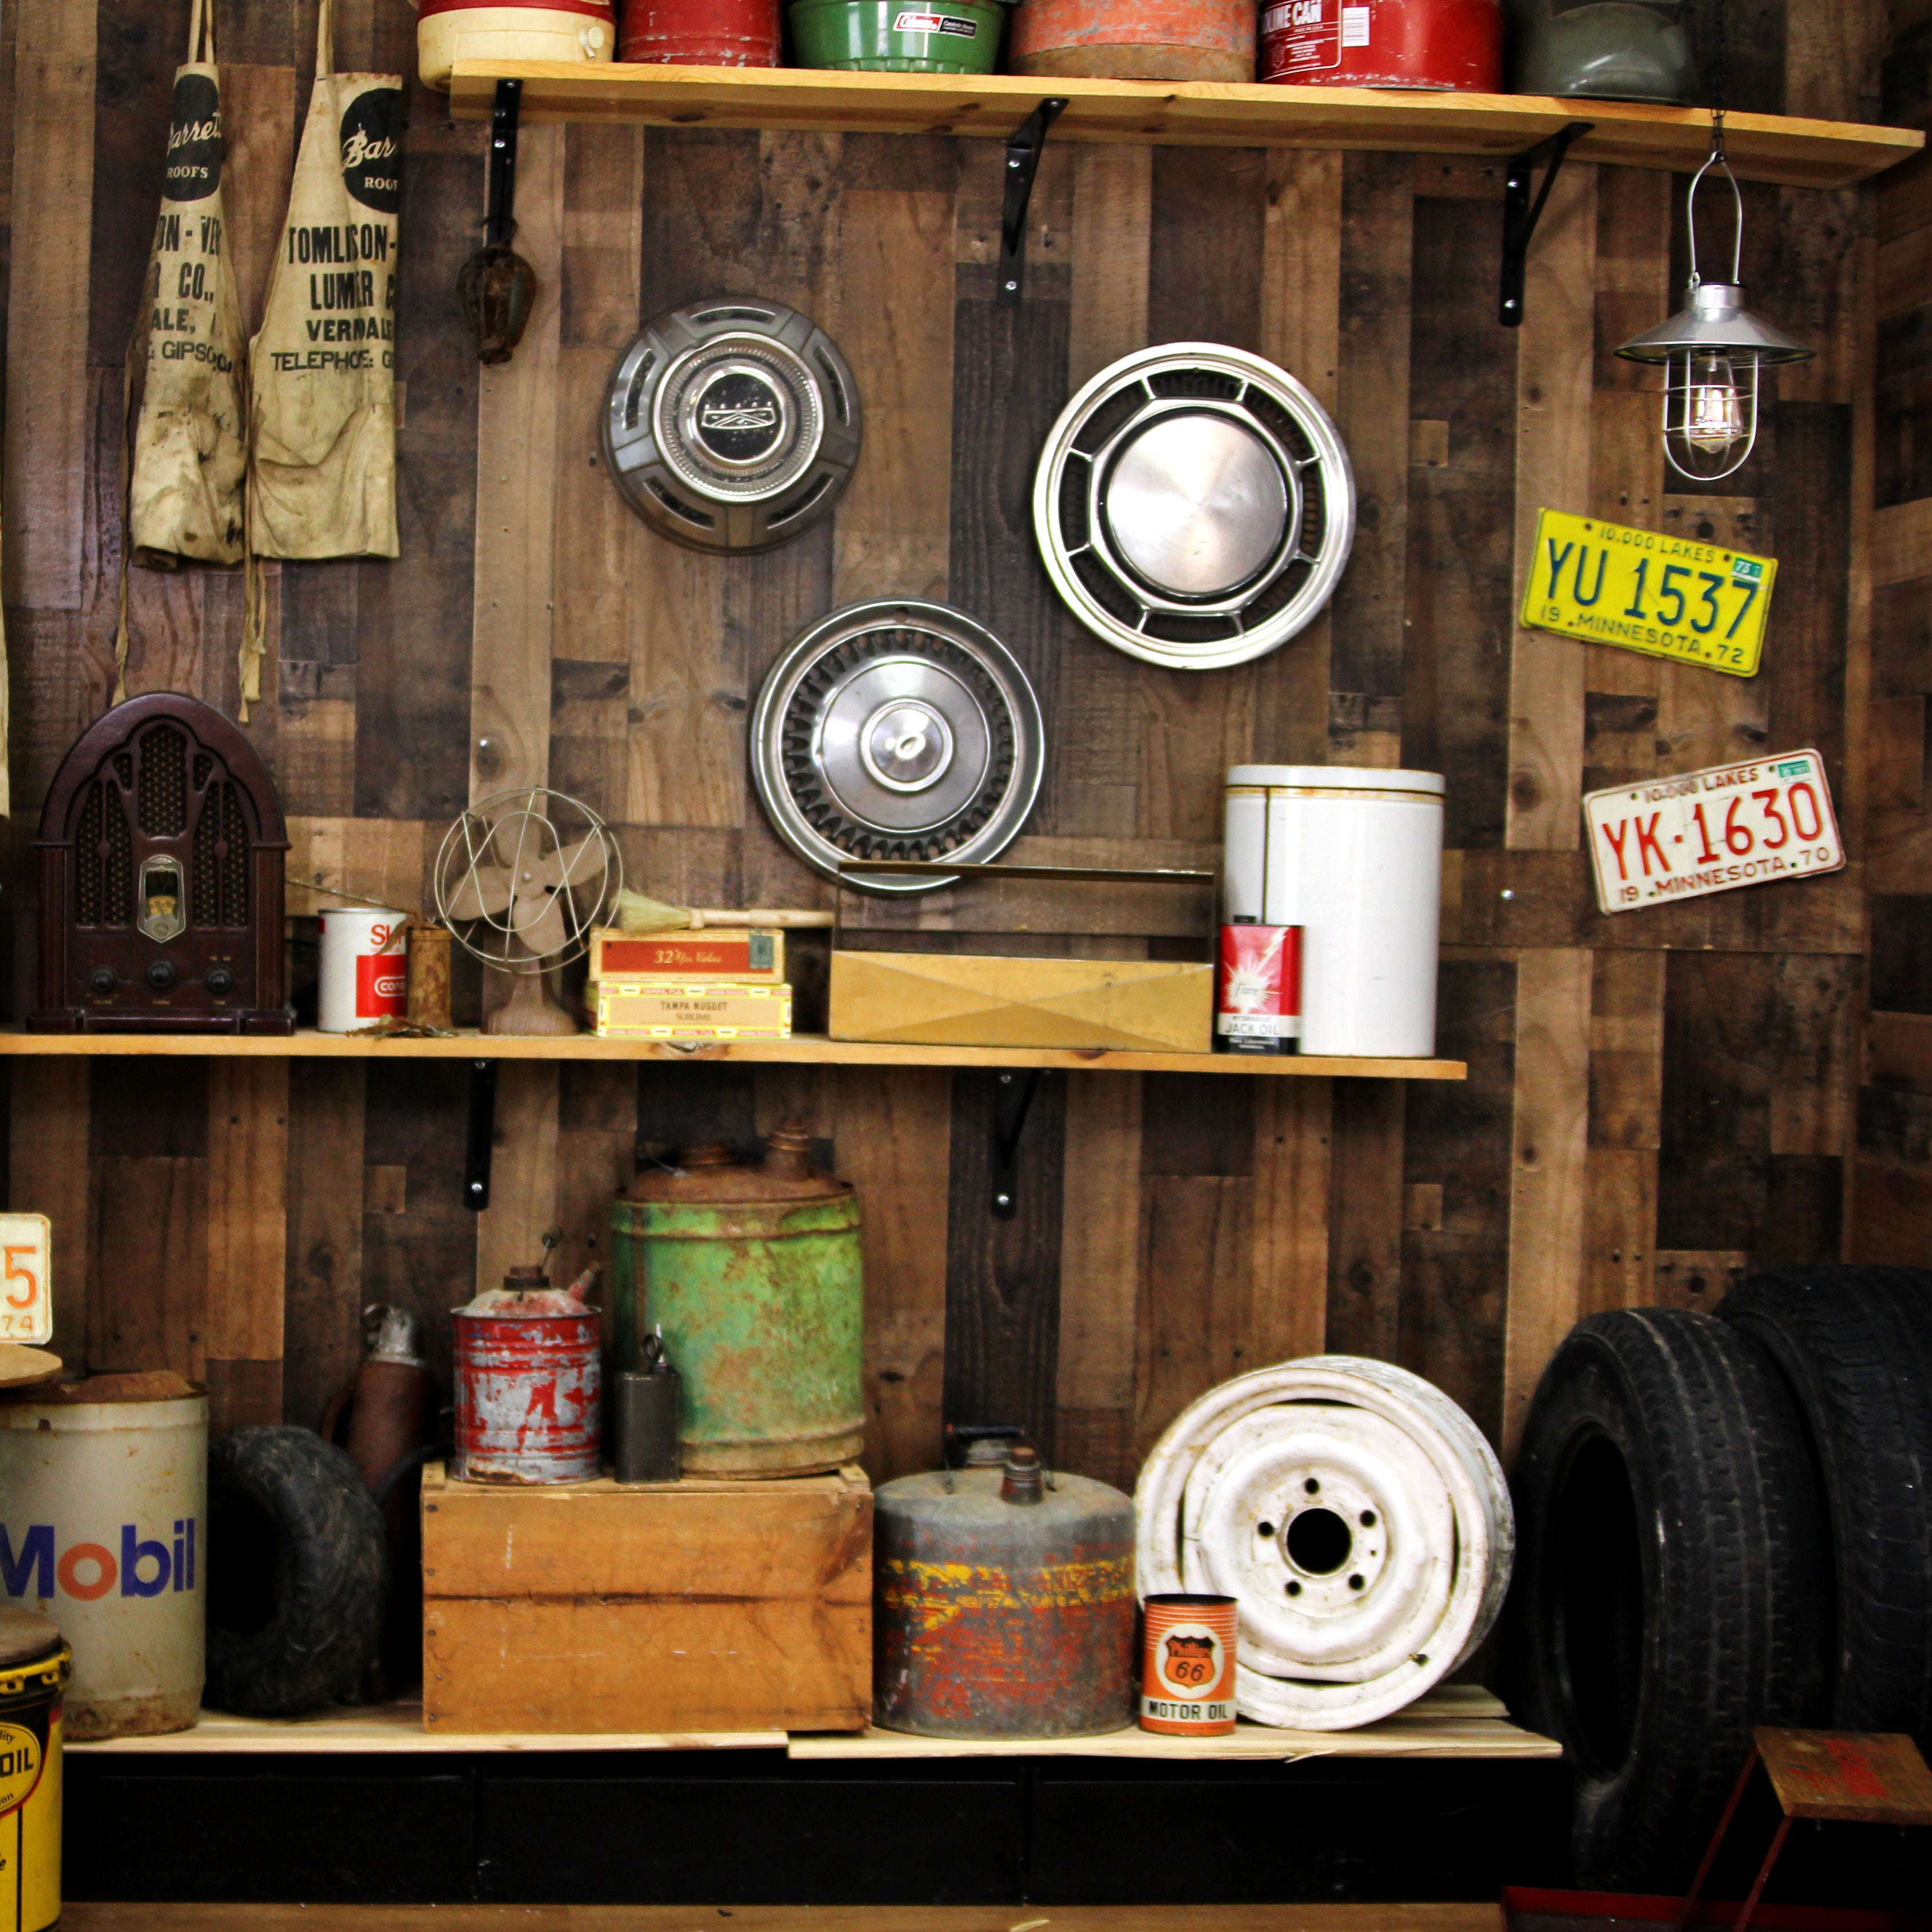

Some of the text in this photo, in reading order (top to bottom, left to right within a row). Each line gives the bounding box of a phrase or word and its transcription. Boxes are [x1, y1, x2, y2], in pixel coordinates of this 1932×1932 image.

[1660, 540, 1715, 563] LAKES
[1547, 537, 1760, 639] YU 1537
[1540, 604, 1744, 664] 19 MINNESOTA 72
[1703, 767, 1759, 791] LAKES
[1620, 847, 1830, 902] 19 MINNESOTA 70
[661, 1001, 728, 1011] TAMPA NUGGET
[1226, 1022, 1280, 1035] JACK OIL
[0, 1518, 195, 1601] Mobil
[1175, 1661, 1205, 1681] 66
[1149, 1701, 1228, 1720] MOTOR OIL
[0, 1747, 34, 1779] OIL
